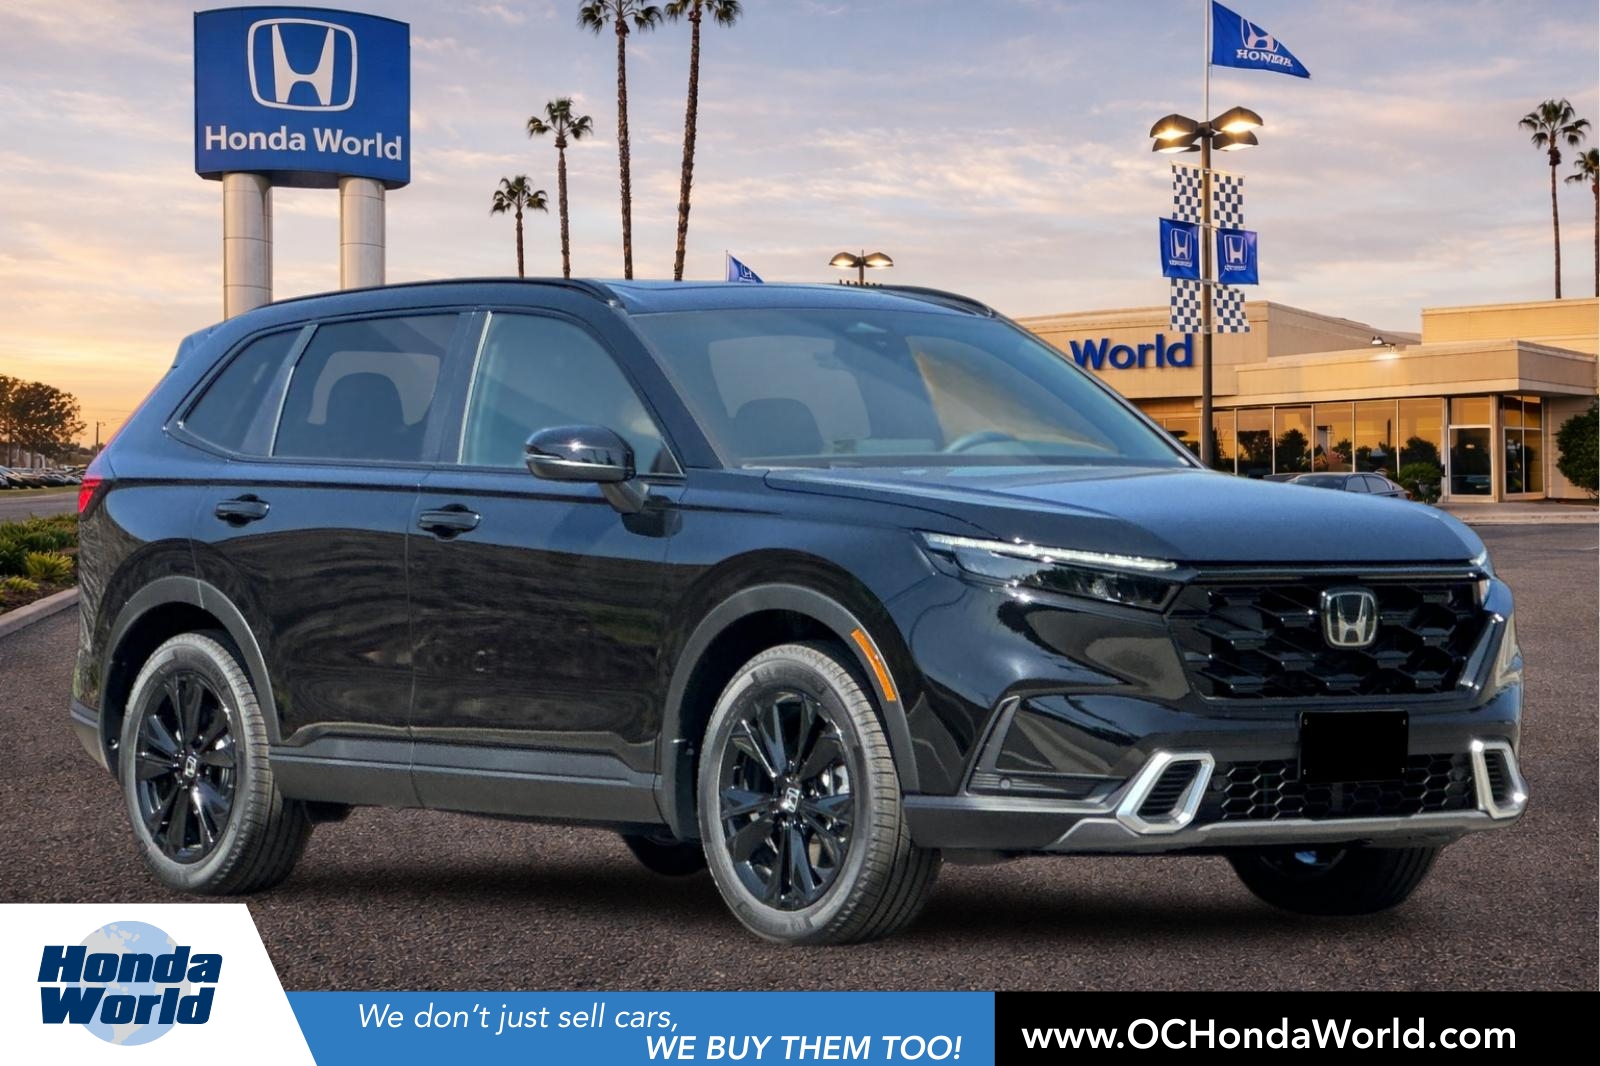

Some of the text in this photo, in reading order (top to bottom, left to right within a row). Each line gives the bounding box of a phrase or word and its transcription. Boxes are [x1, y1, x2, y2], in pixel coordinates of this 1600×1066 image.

[205, 125, 402, 161] Honda World
[1069, 333, 1194, 371] World
